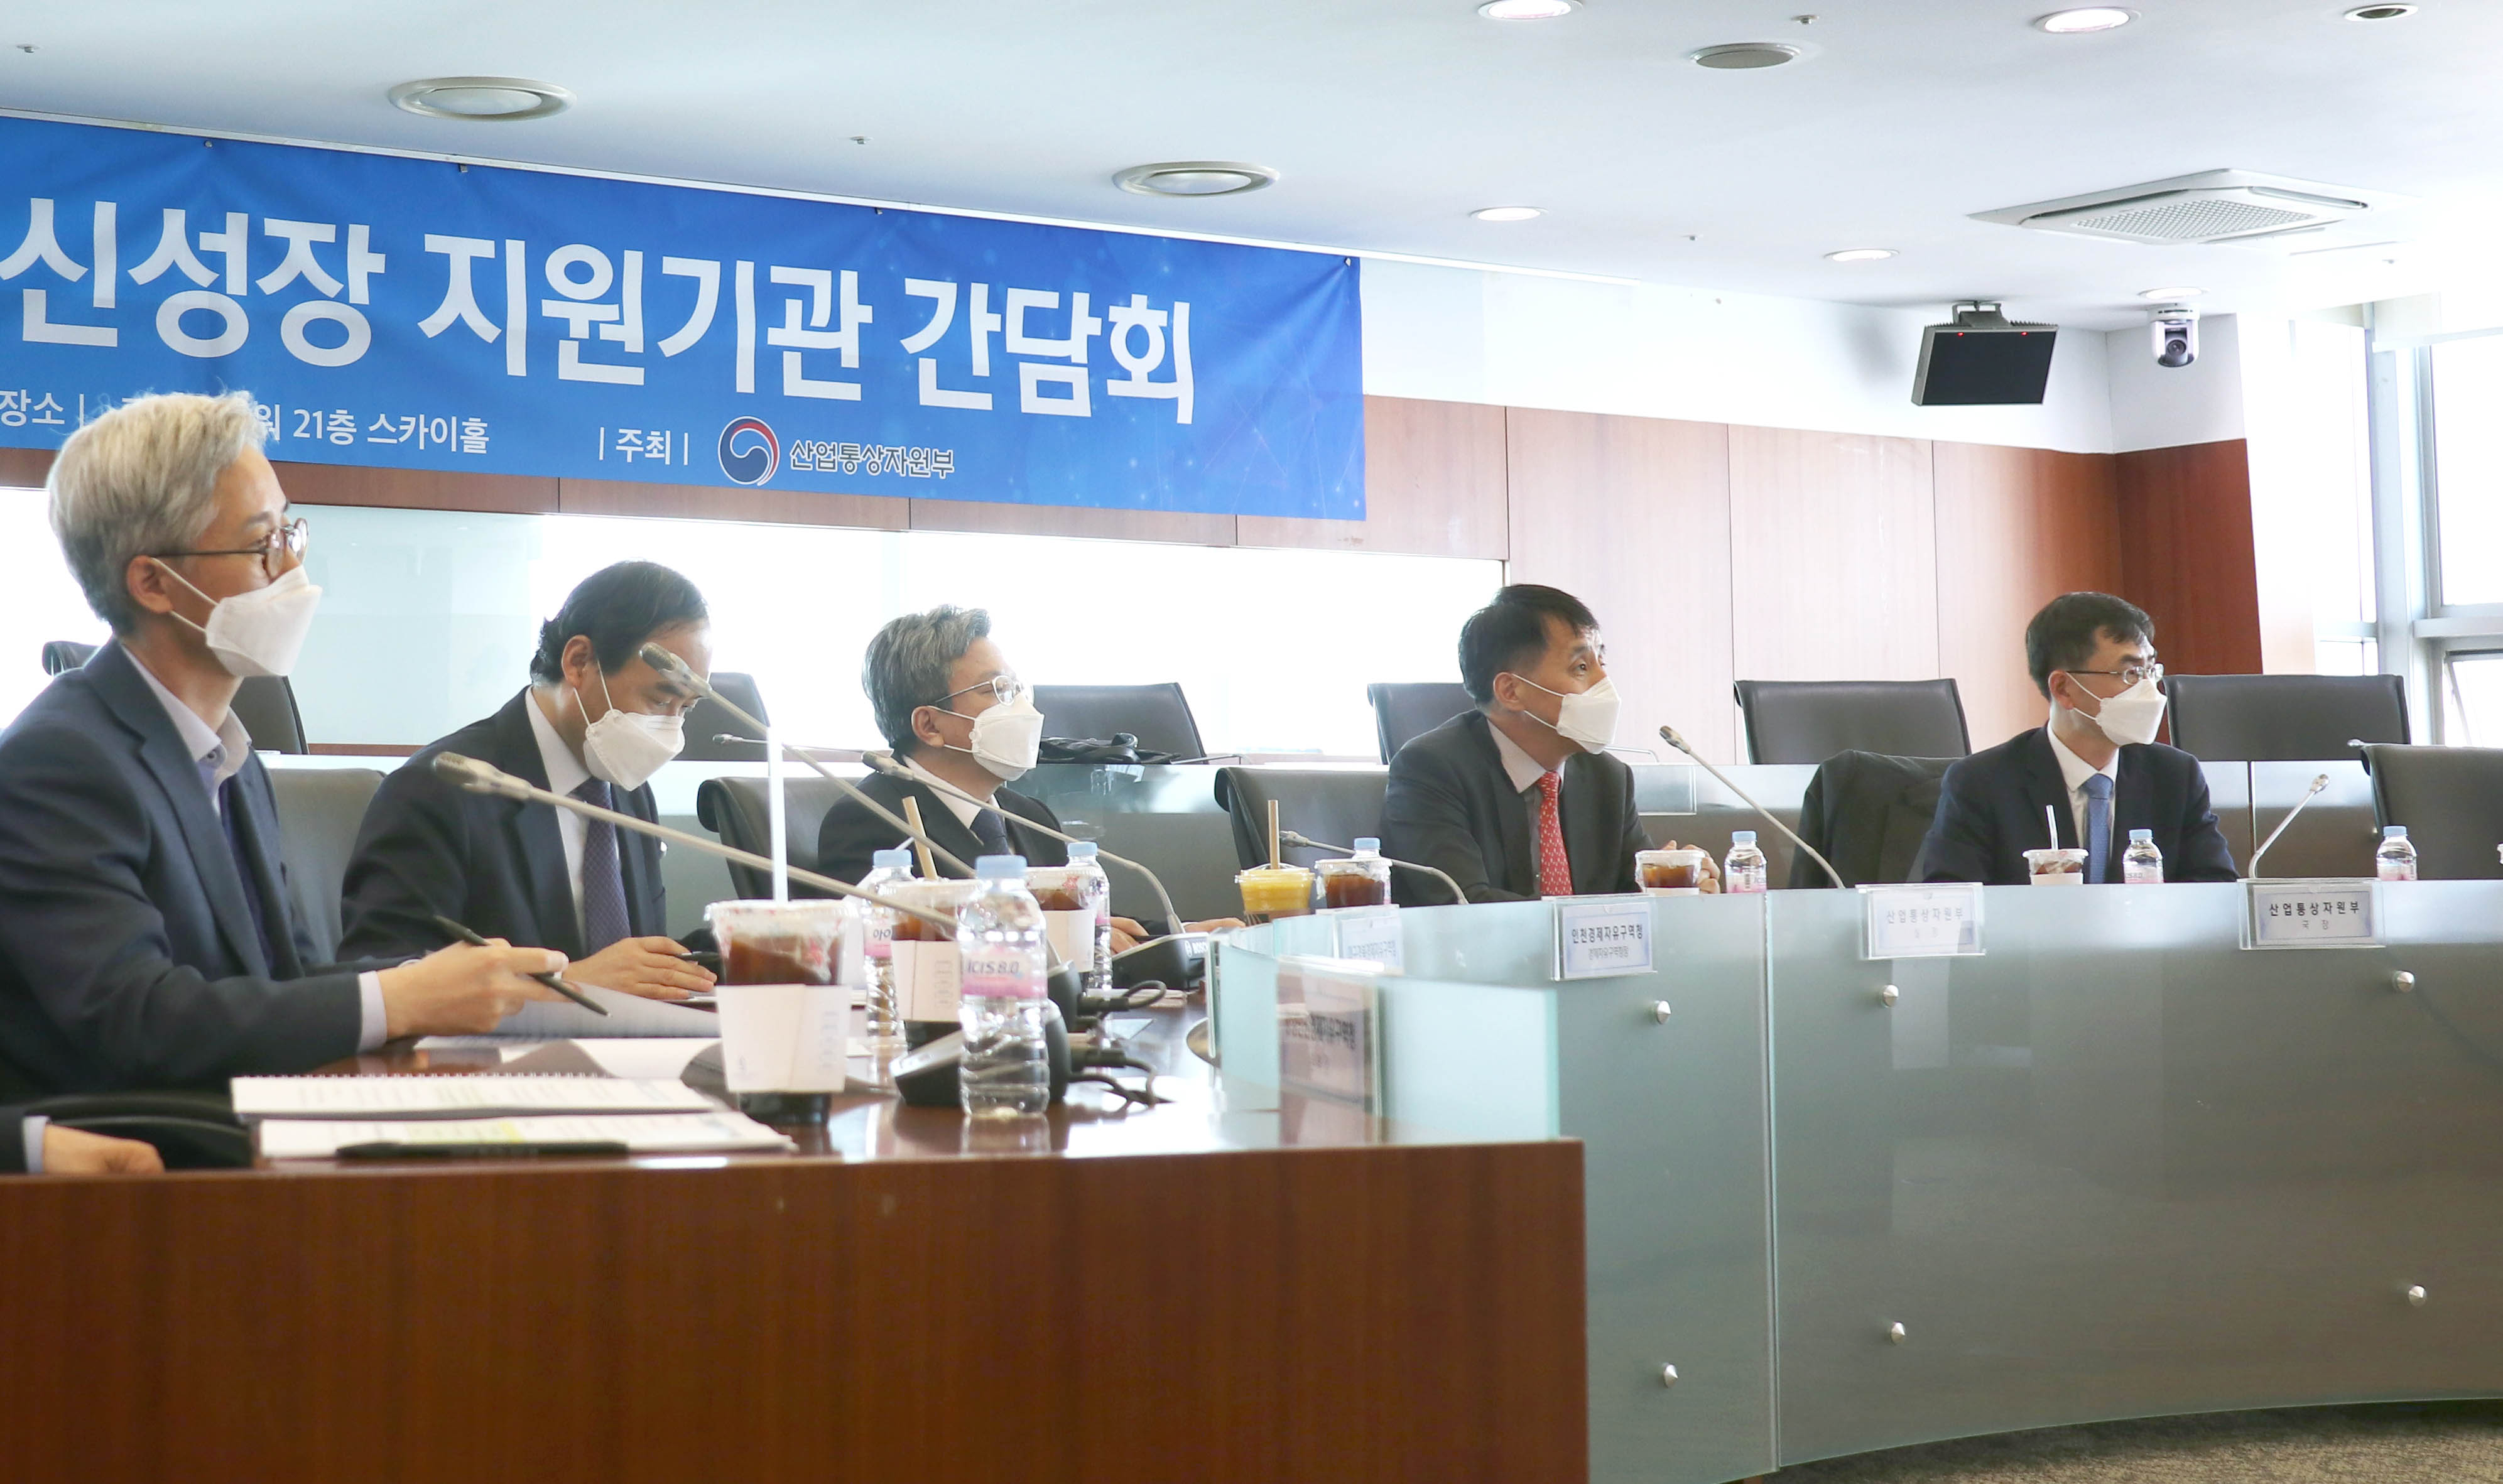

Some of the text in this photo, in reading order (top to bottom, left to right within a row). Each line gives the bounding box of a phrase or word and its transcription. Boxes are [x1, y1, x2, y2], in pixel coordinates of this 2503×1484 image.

[0, 198, 1195, 425] 신성장 지원기관 간담회
[0, 389, 65, 427] 장소
[293, 408, 357, 446] 21층
[367, 413, 490, 455] 스카이홀
[615, 427, 671, 465] 주최
[790, 440, 955, 479] 산업통상자원부
[2269, 901, 2360, 917] 산업통상자원부
[1572, 924, 1643, 944] 인천경제자유구역청
